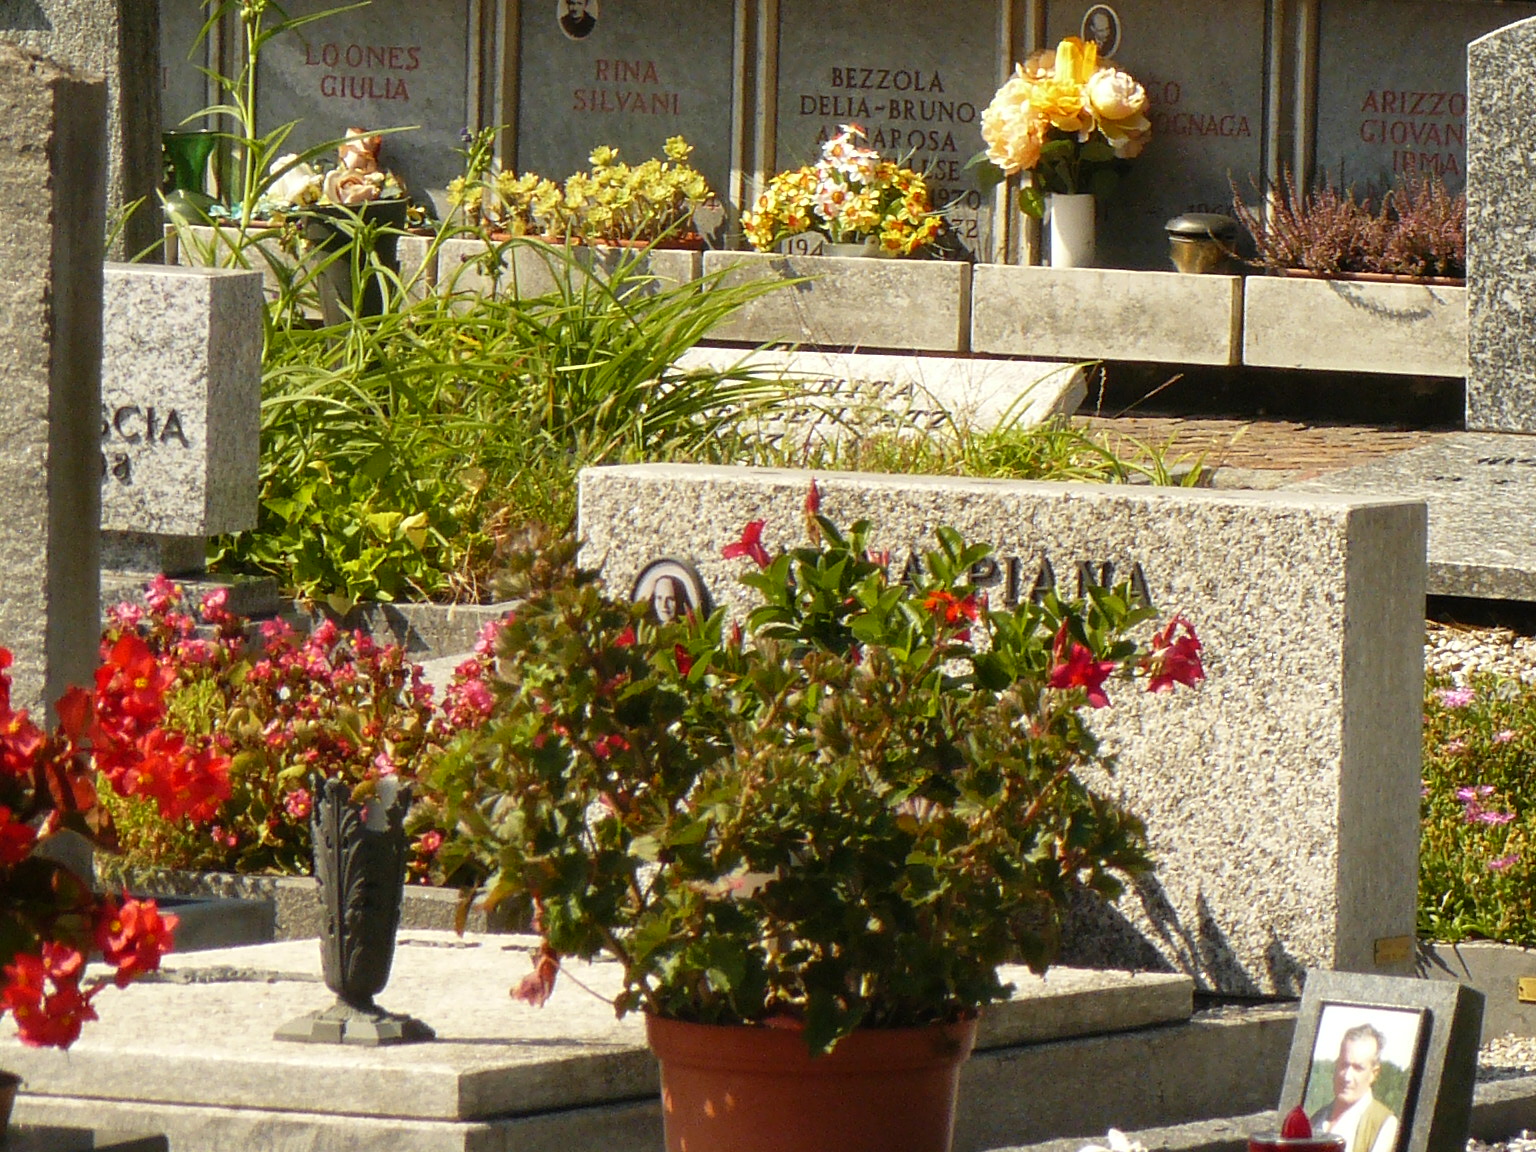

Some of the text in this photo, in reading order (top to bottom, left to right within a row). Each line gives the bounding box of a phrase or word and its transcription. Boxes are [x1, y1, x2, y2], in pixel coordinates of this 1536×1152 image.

[593, 58, 660, 85] RINA
[830, 65, 946, 94] BEZZOLA
[320, 74, 410, 103] GIULIA
[572, 87, 682, 117] SILVANI
